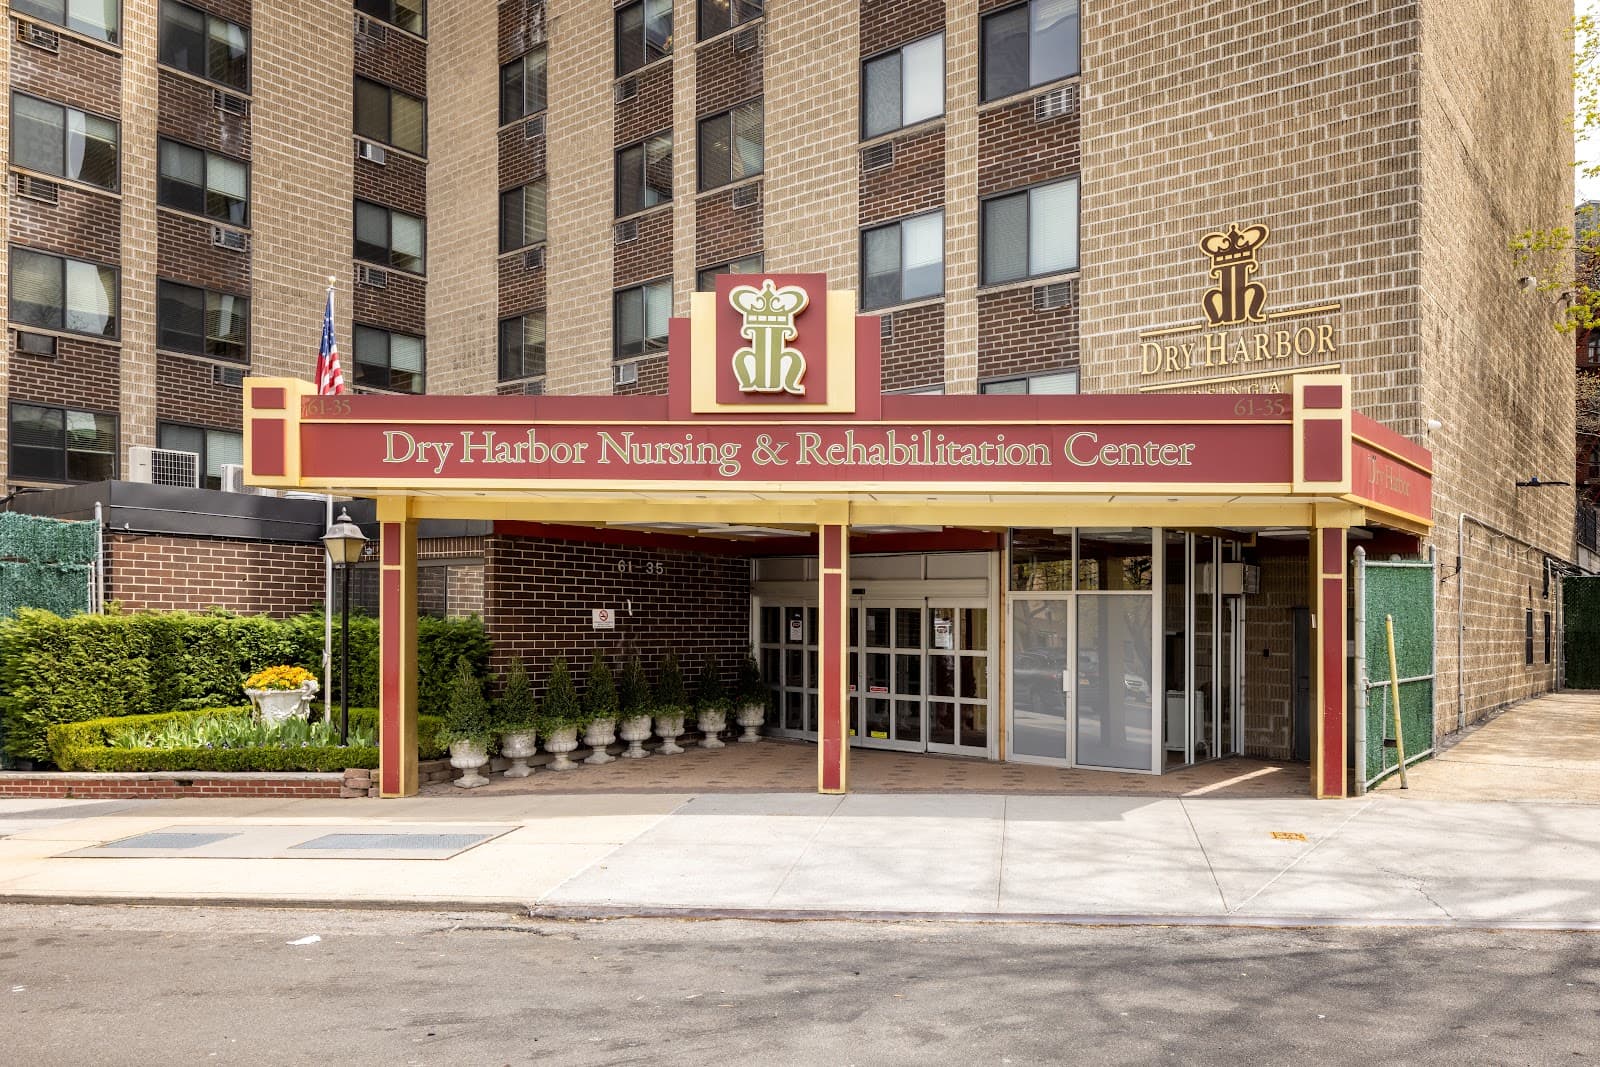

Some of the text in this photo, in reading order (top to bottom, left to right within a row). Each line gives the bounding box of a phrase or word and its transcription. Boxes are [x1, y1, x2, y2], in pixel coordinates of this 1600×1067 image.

[1140, 324, 1337, 376] DRY HARBOR
[306, 399, 353, 416] 61-35
[1233, 398, 1285, 416] 61-35
[382, 428, 1196, 477] Dry Harbor Nursing & Rehabilitation Center
